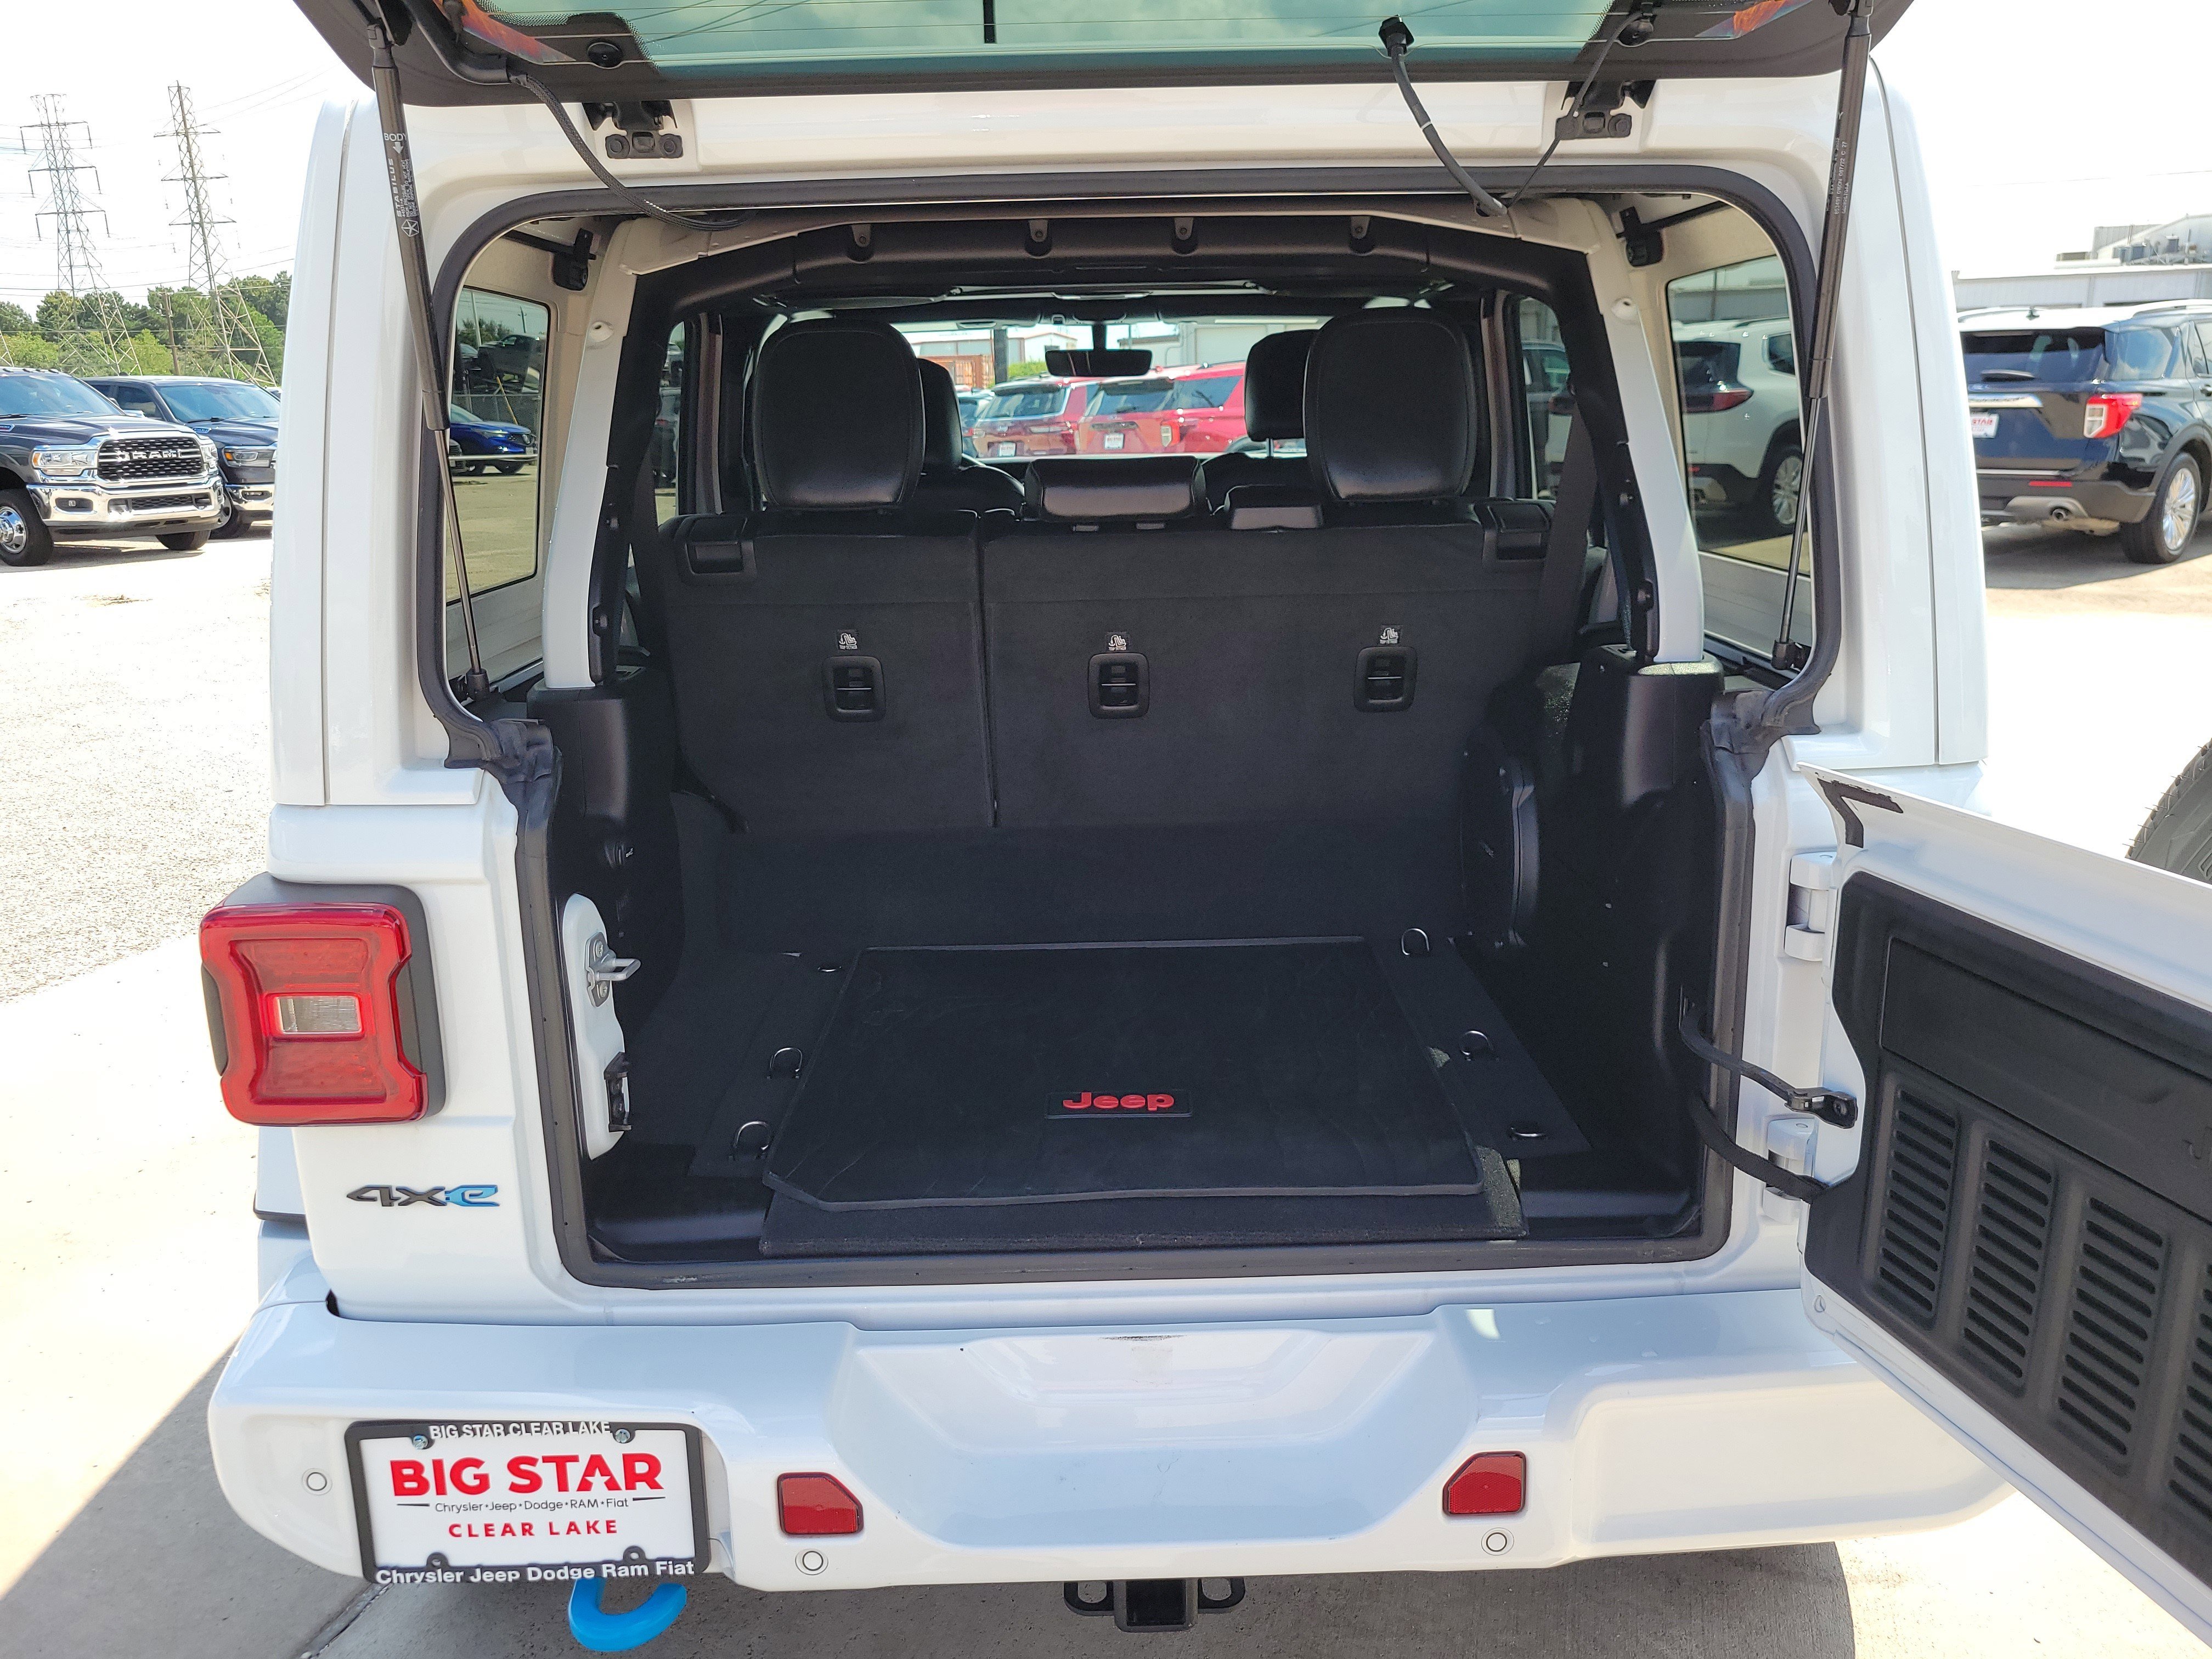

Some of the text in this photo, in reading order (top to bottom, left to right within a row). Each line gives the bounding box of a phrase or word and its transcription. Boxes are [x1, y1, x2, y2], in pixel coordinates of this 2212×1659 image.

[388, 158, 402, 217] STABILUS
[132, 451, 177, 459] RAM
[1063, 1092, 1174, 1110] Jeep
[430, 1421, 611, 1439] BIG STAR CLEAR LAKE
[390, 1453, 664, 1496] BIG STAR
[435, 1498, 629, 1514] Chrysler Jeep Dodge RAM Fiat
[449, 1520, 617, 1537] CLEAR LAKE
[375, 1560, 695, 1584] Chrysler Jeep Dodge Ram Fiat
